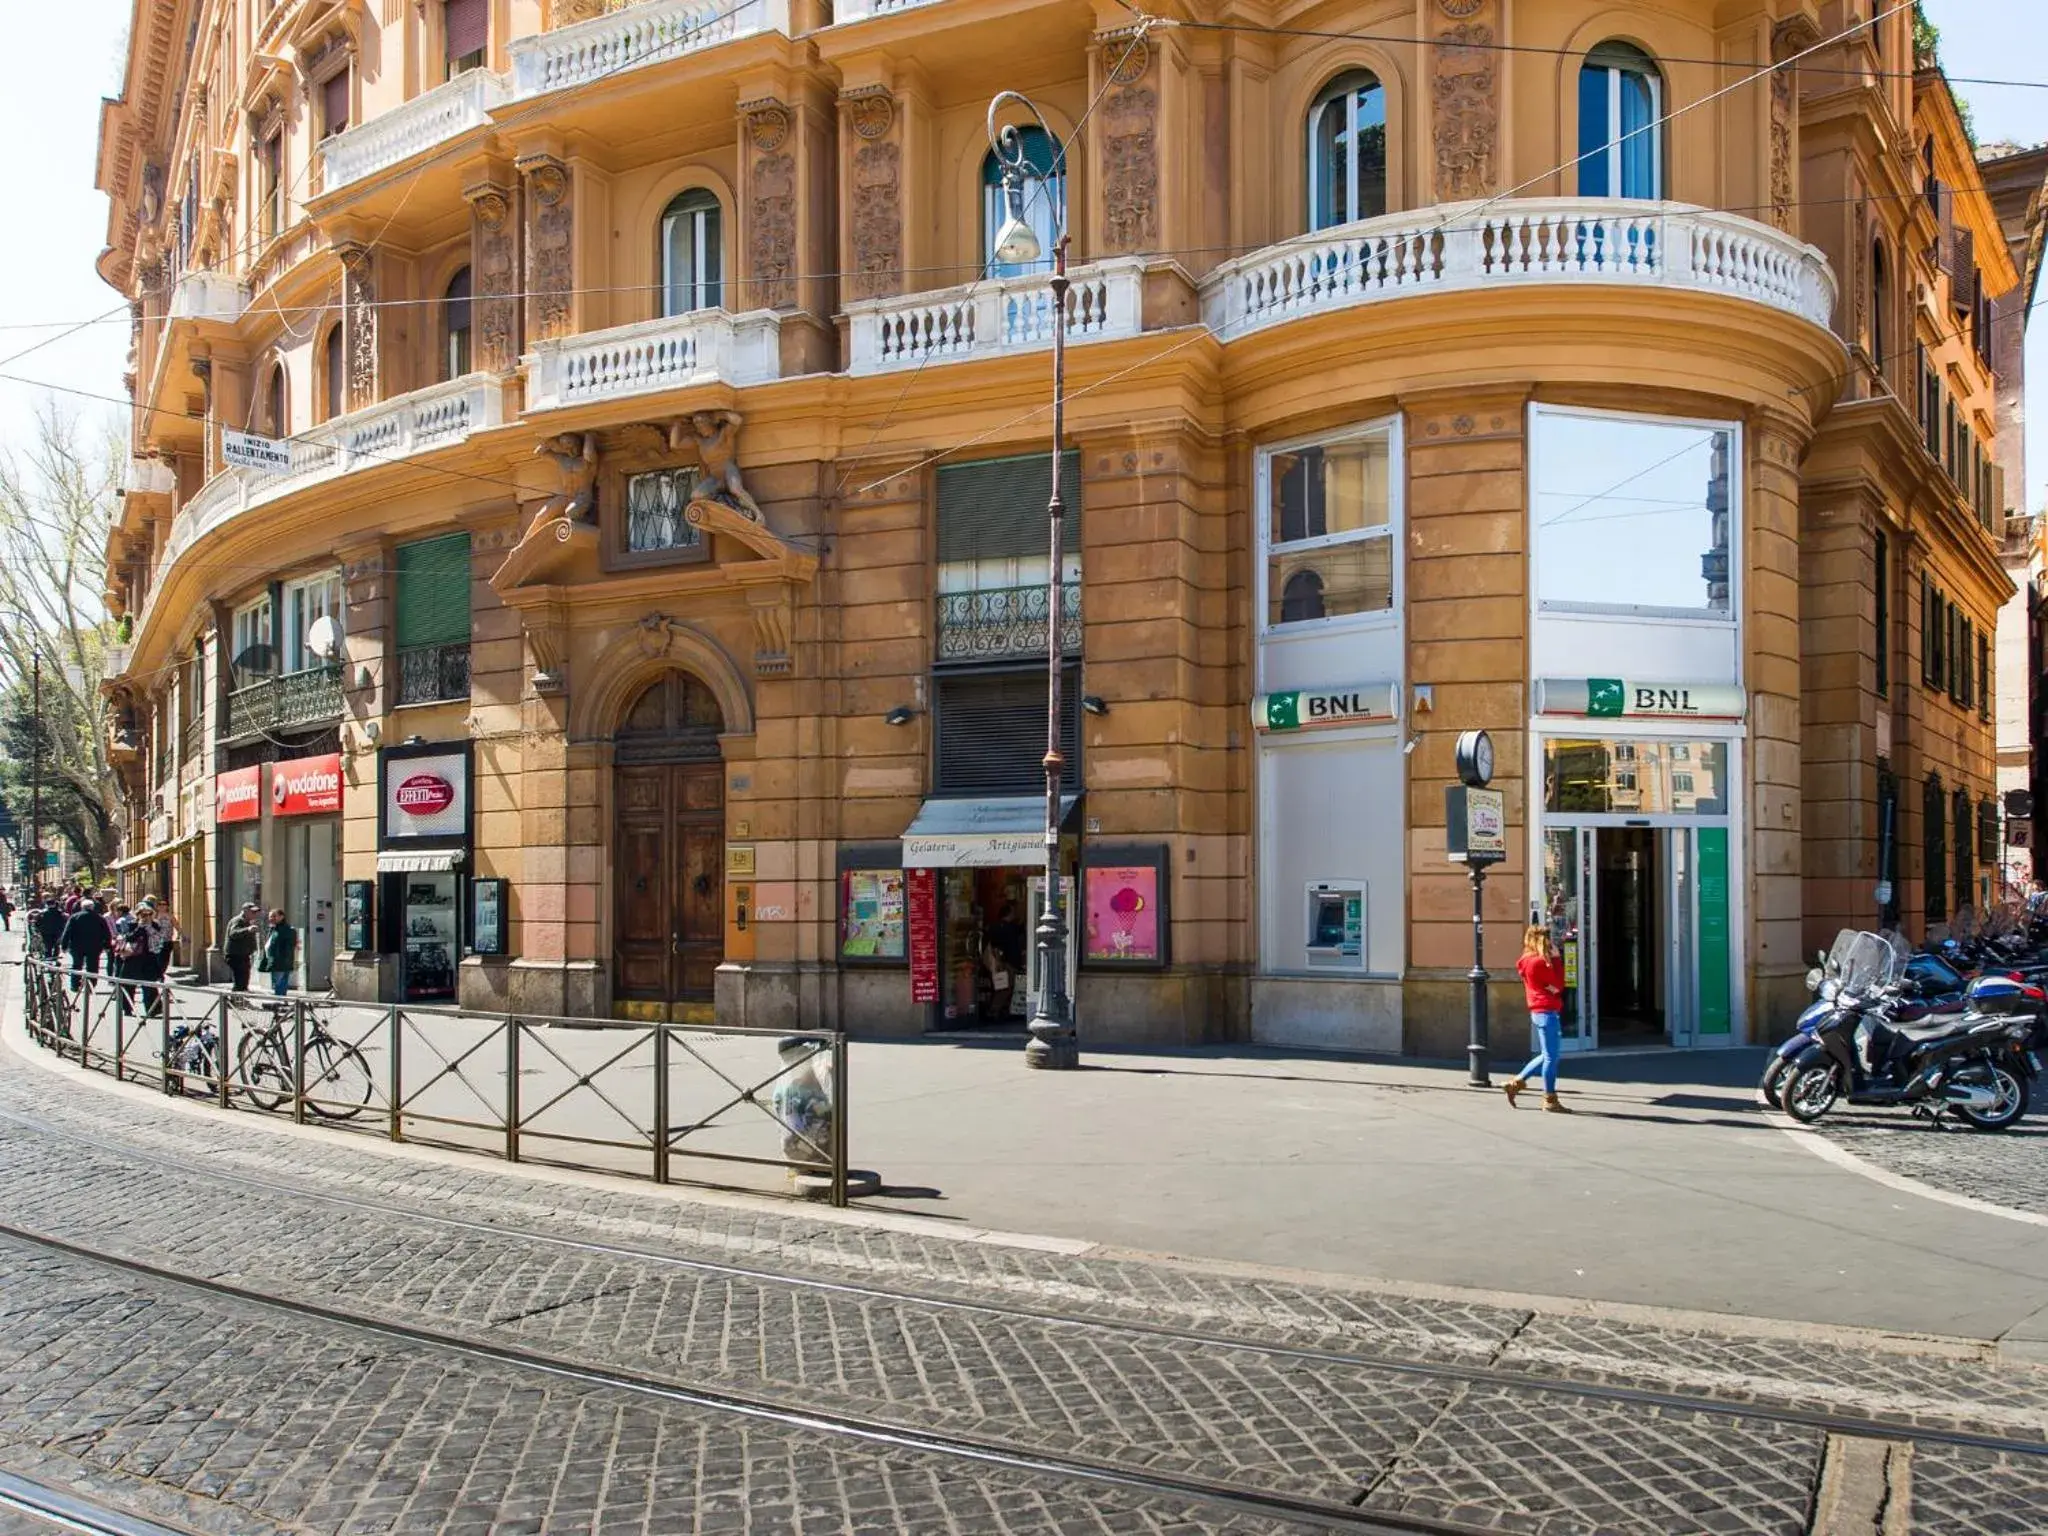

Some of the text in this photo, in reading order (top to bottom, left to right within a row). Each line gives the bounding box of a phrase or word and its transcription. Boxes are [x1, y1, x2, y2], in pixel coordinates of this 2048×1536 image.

[226, 443, 288, 464] RALLENTAMENTO
[244, 438, 270, 448] INIZIO
[1309, 694, 1369, 716] BNL
[1635, 688, 1698, 710] BNL
[226, 782, 257, 802] vodafone
[287, 771, 338, 795] vodafone
[911, 840, 955, 855] Gelateria
